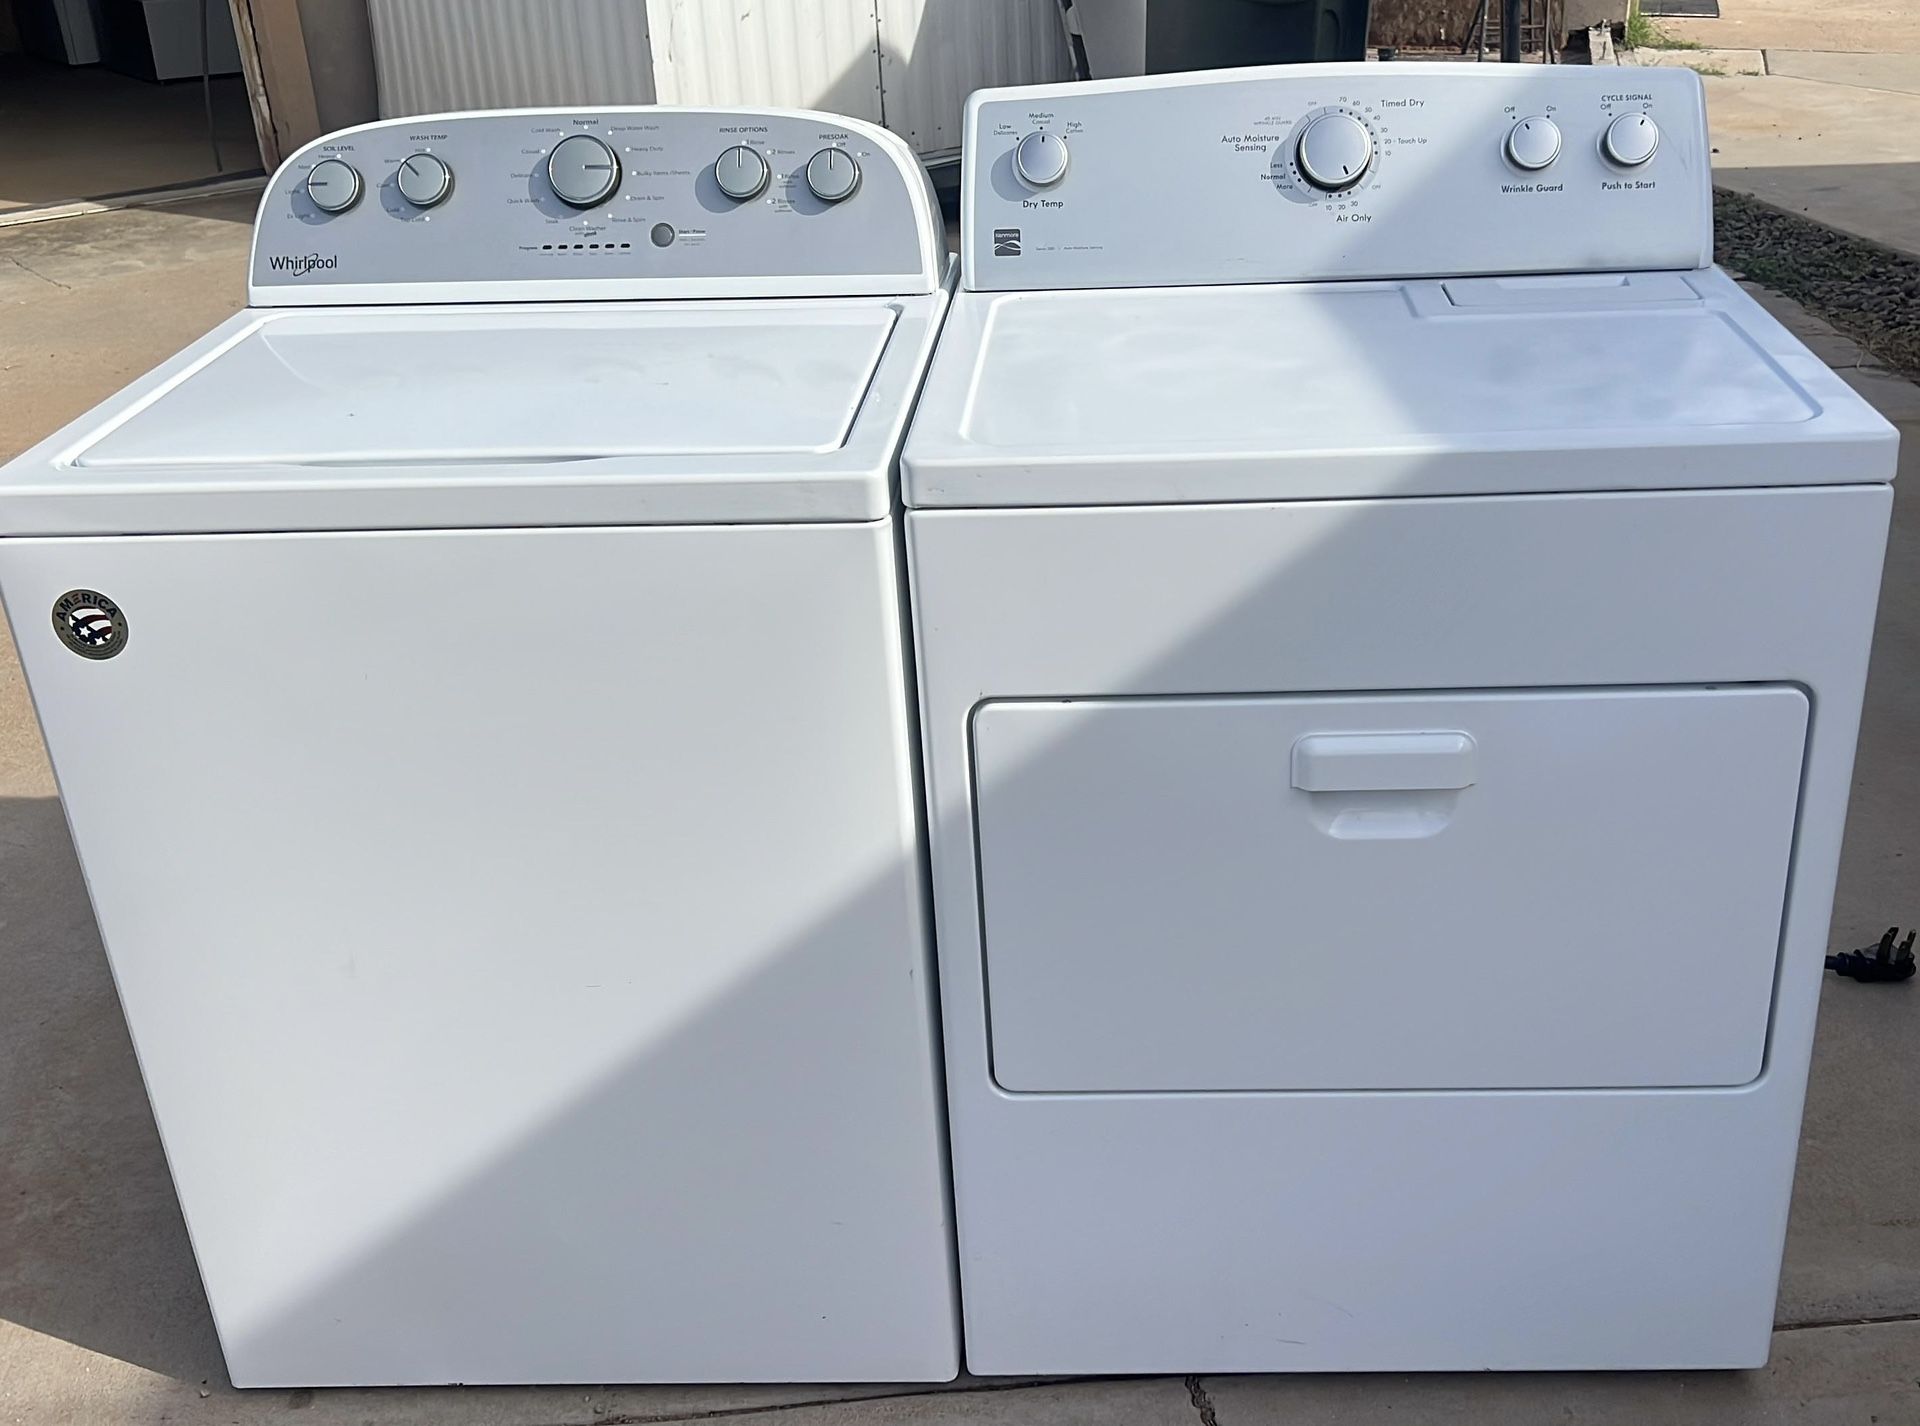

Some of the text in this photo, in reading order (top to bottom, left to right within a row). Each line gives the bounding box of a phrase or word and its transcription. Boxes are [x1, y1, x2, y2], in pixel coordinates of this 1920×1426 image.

[1601, 94, 1623, 102] CYCLE
[1410, 99, 1424, 107] Dry
[1221, 134, 1279, 143] Auto Moisture
[1235, 144, 1267, 152] Sensing
[1501, 184, 1563, 193] Wrinkle Guard
[1602, 182, 1621, 190] Push
[1635, 181, 1656, 189] Start
[1023, 200, 1064, 209] Dry Temp
[1351, 213, 1372, 222] Only
[270, 254, 337, 275] Whirlpool
[56, 593, 117, 622] AMERICA
